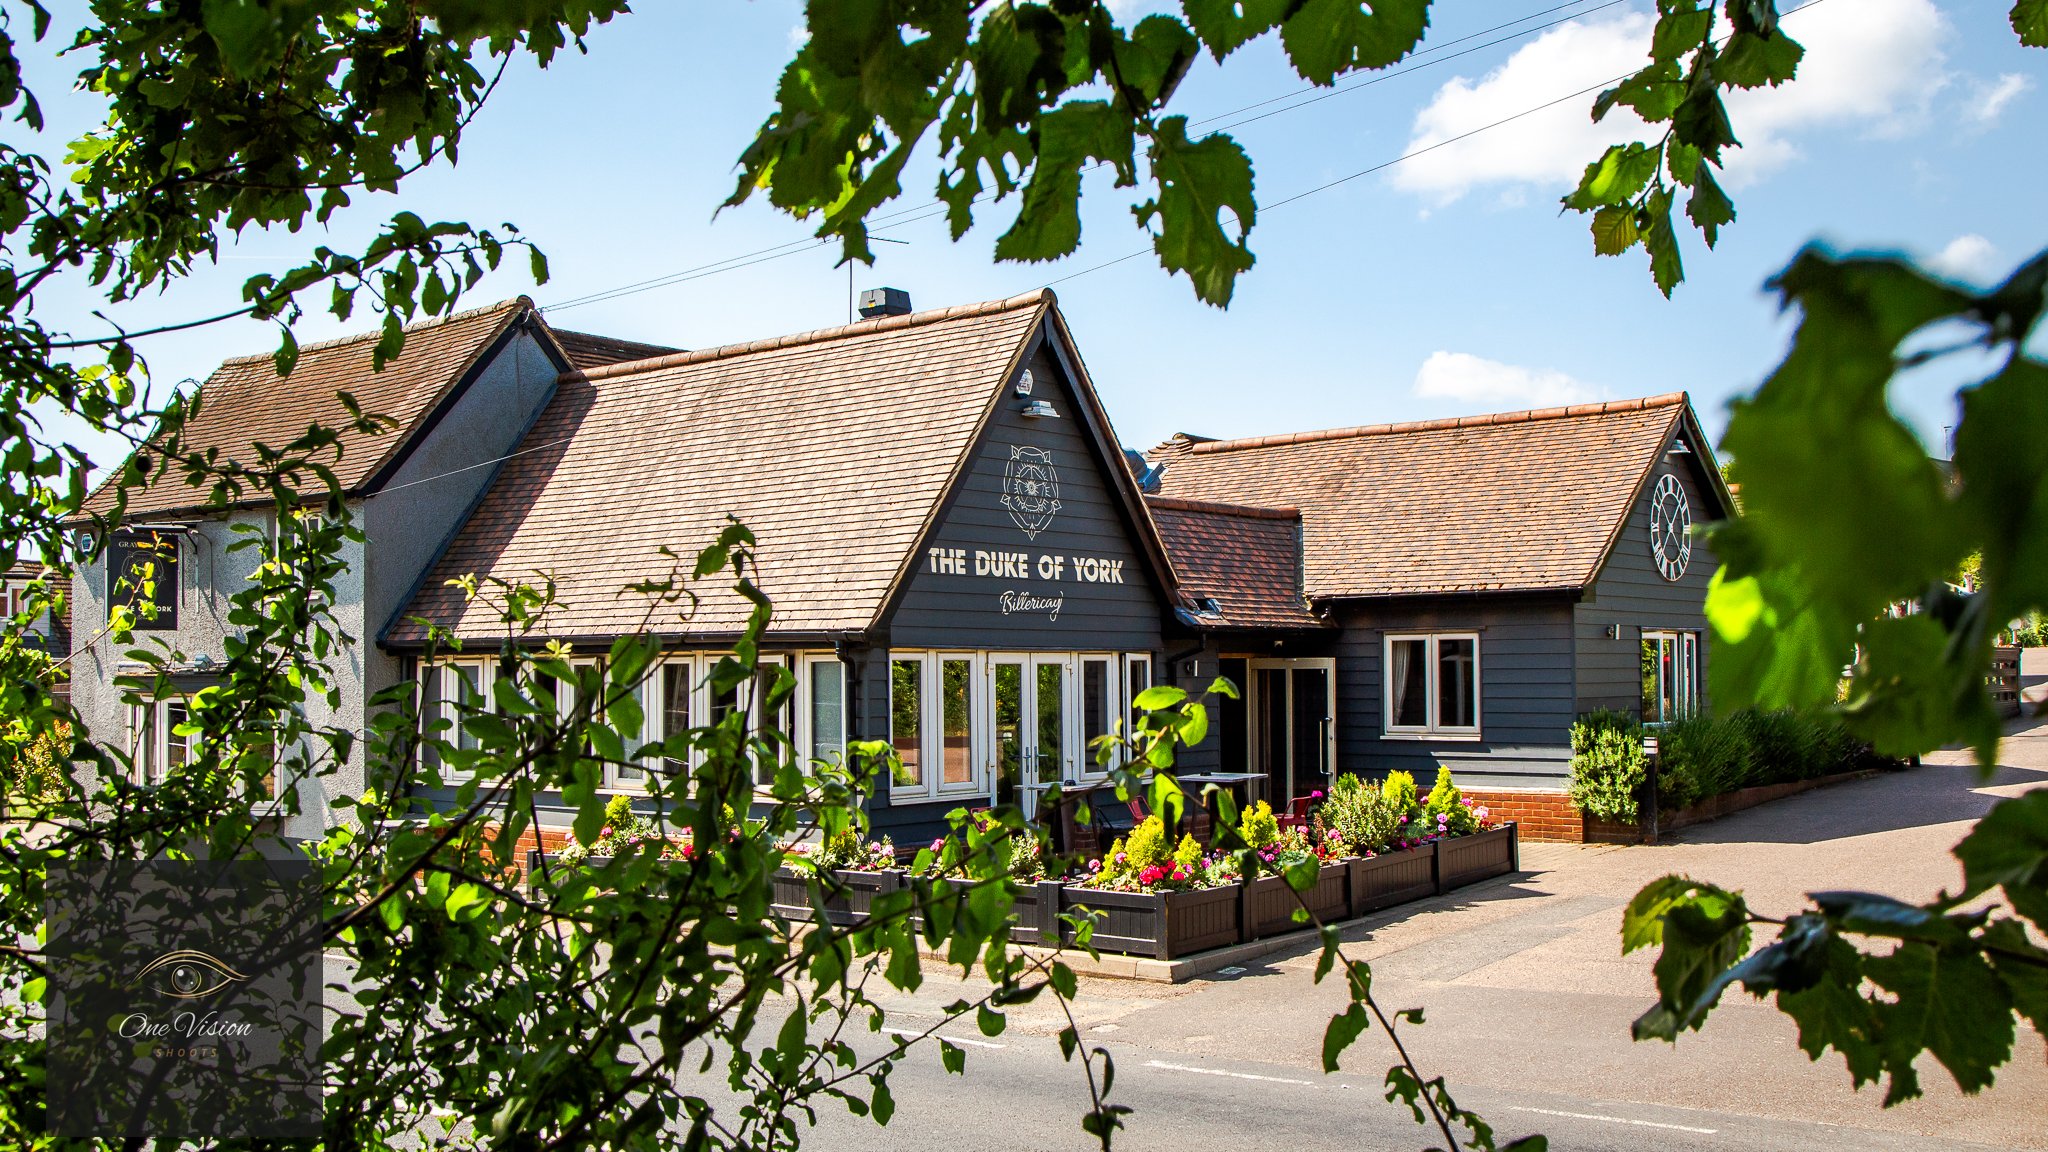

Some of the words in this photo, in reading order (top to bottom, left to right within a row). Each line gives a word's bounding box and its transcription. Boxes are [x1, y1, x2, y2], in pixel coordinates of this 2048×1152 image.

[928, 547, 967, 575] THE
[975, 550, 1029, 579] DUKE
[1037, 554, 1065, 581] OF
[1072, 556, 1124, 584] YORK
[1000, 590, 1064, 622] Billericay
